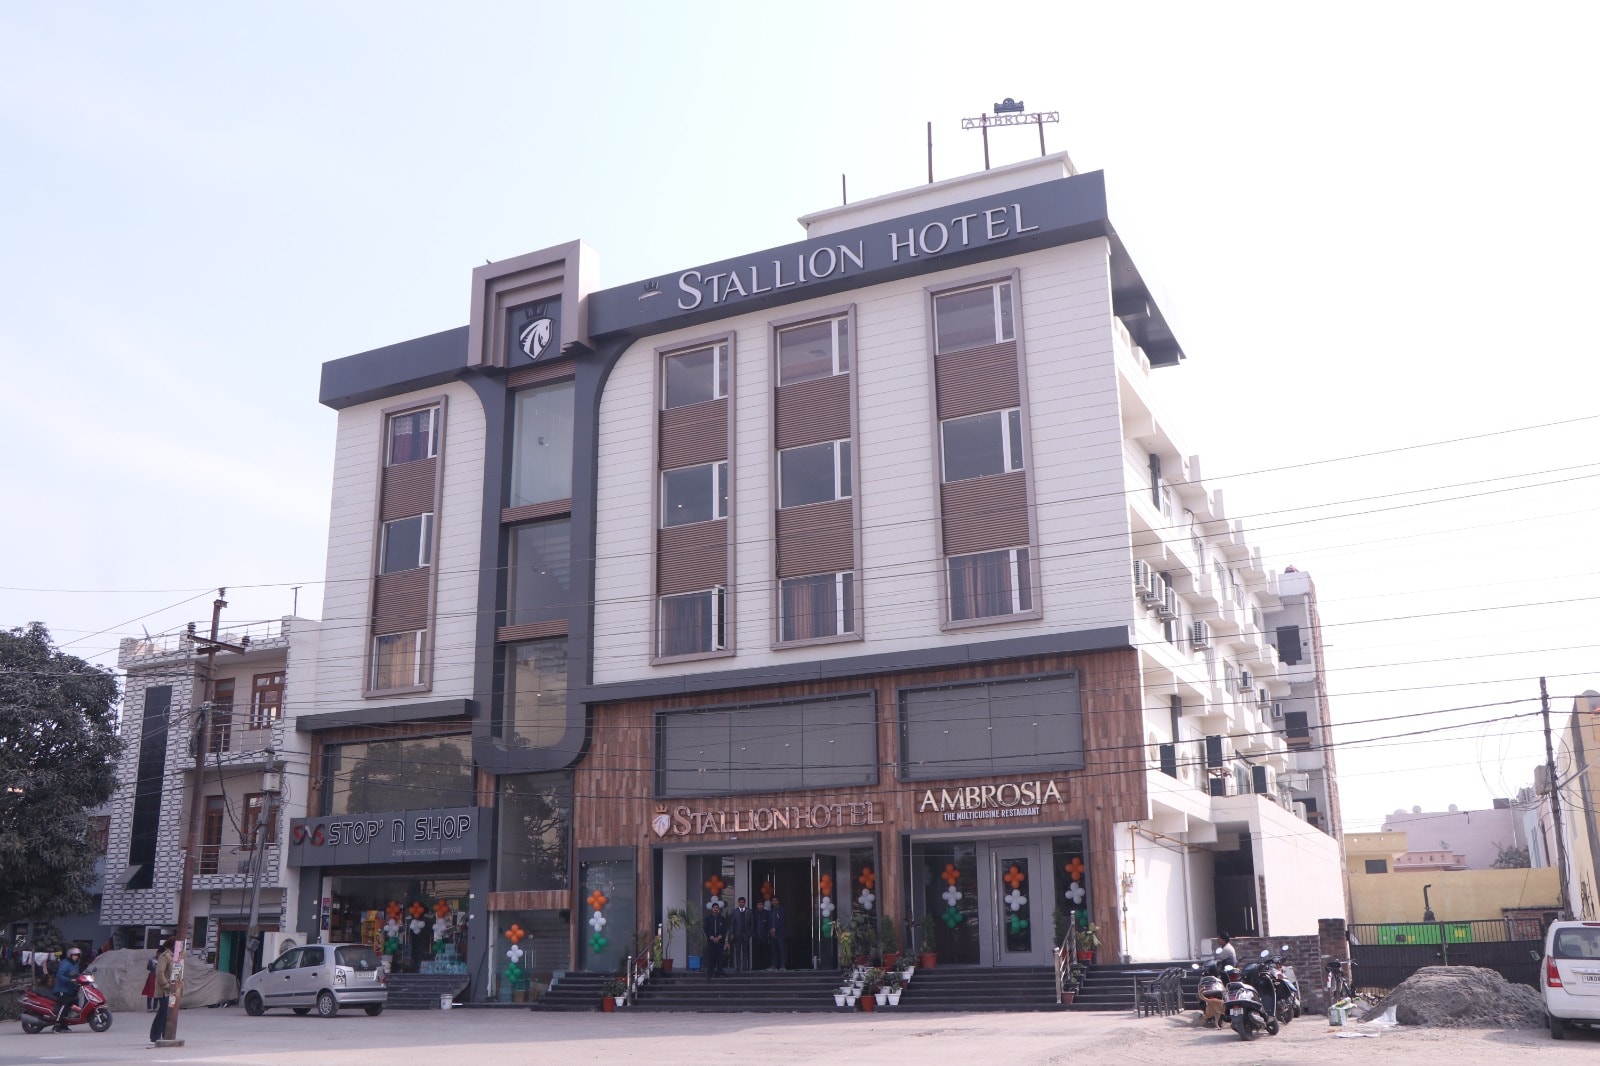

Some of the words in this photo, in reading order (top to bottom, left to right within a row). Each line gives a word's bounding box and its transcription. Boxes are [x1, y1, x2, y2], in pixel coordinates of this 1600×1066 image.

[963, 111, 1057, 128] AMBROSIA
[677, 240, 865, 311] STALLION
[888, 203, 1040, 262] HOTEL
[919, 780, 1064, 813] AMBROSIA
[414, 814, 471, 841] SHOP
[673, 805, 790, 836] STALLION
[792, 801, 883, 829] HOTEL
[943, 812, 956, 821] THE
[957, 809, 999, 821] MULTICUISINE
[1001, 807, 1041, 818] RESTAURANT
